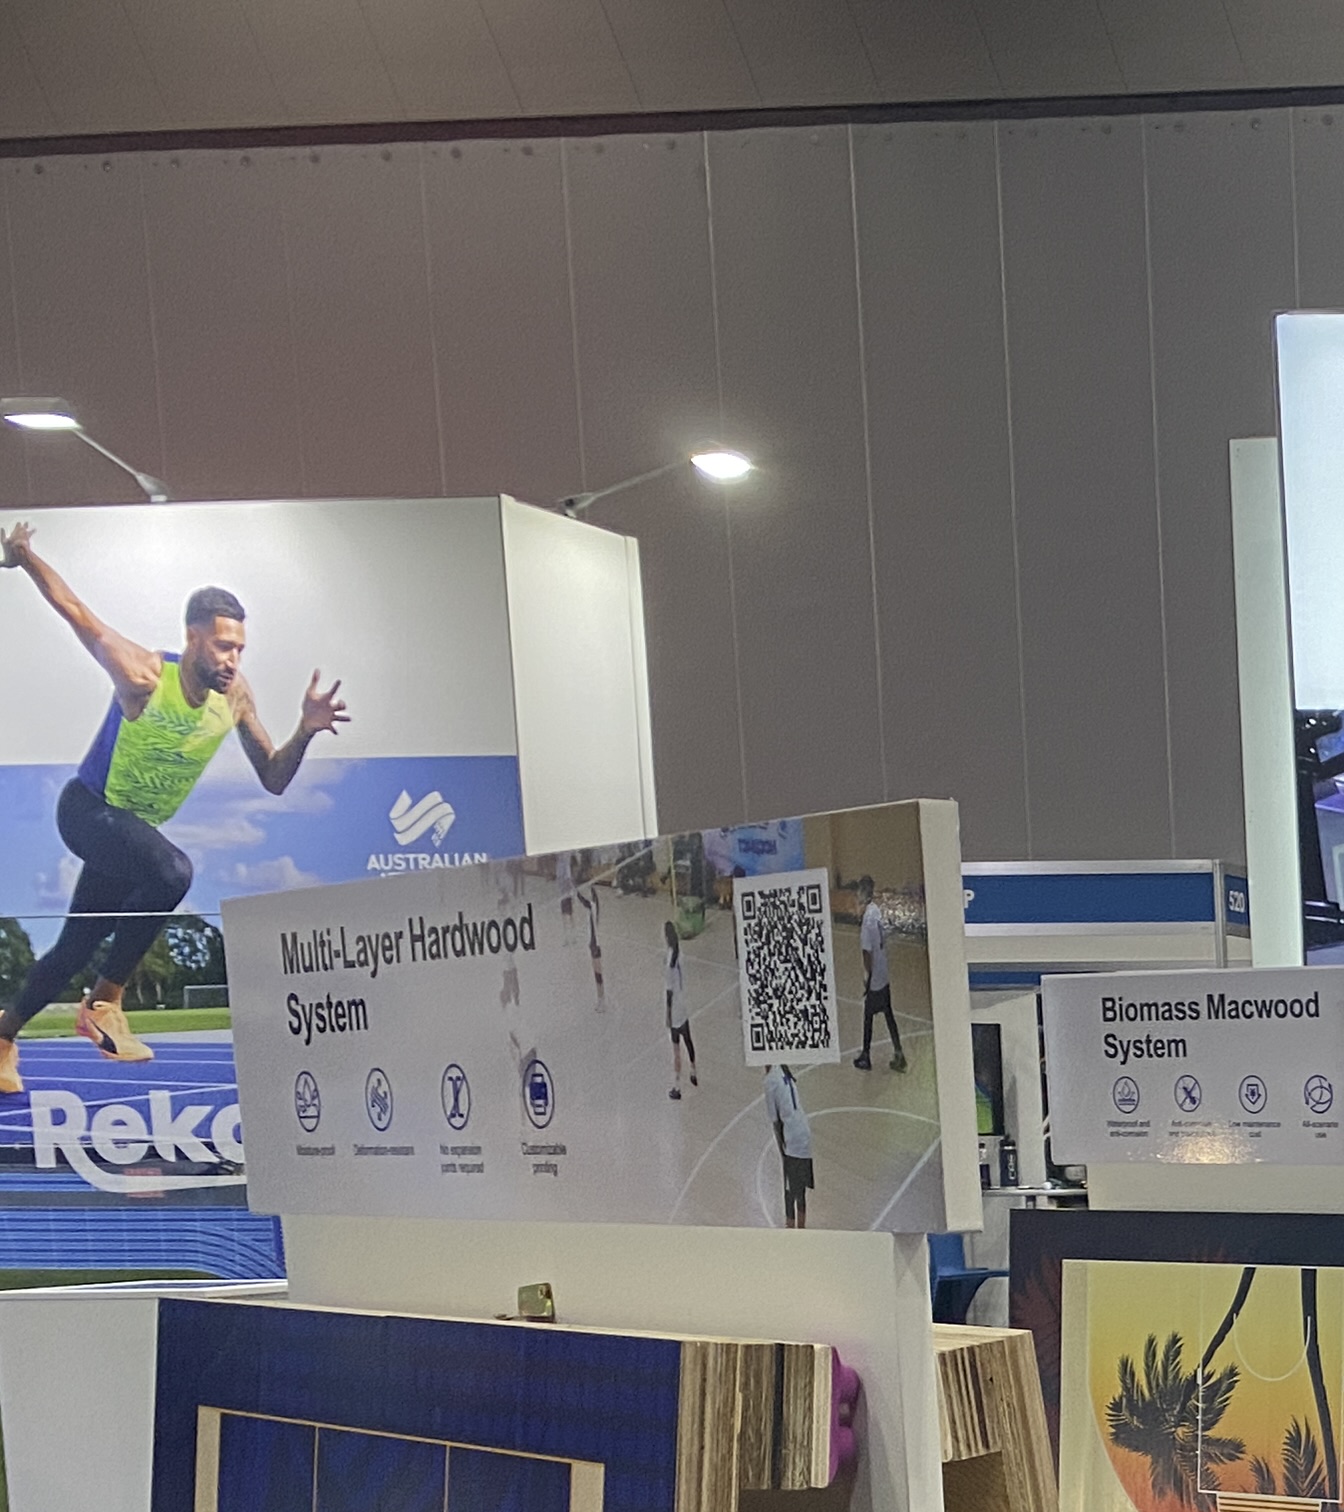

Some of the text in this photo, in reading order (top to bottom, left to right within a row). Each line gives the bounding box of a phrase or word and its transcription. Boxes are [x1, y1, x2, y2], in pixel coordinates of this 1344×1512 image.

[366, 852, 488, 871] AUSTRALIAN
[280, 904, 536, 979] Multi-Layer Hardwood
[286, 992, 369, 1047] System
[1101, 992, 1320, 1023] Biomass Macwood
[1103, 1032, 1188, 1066] System
